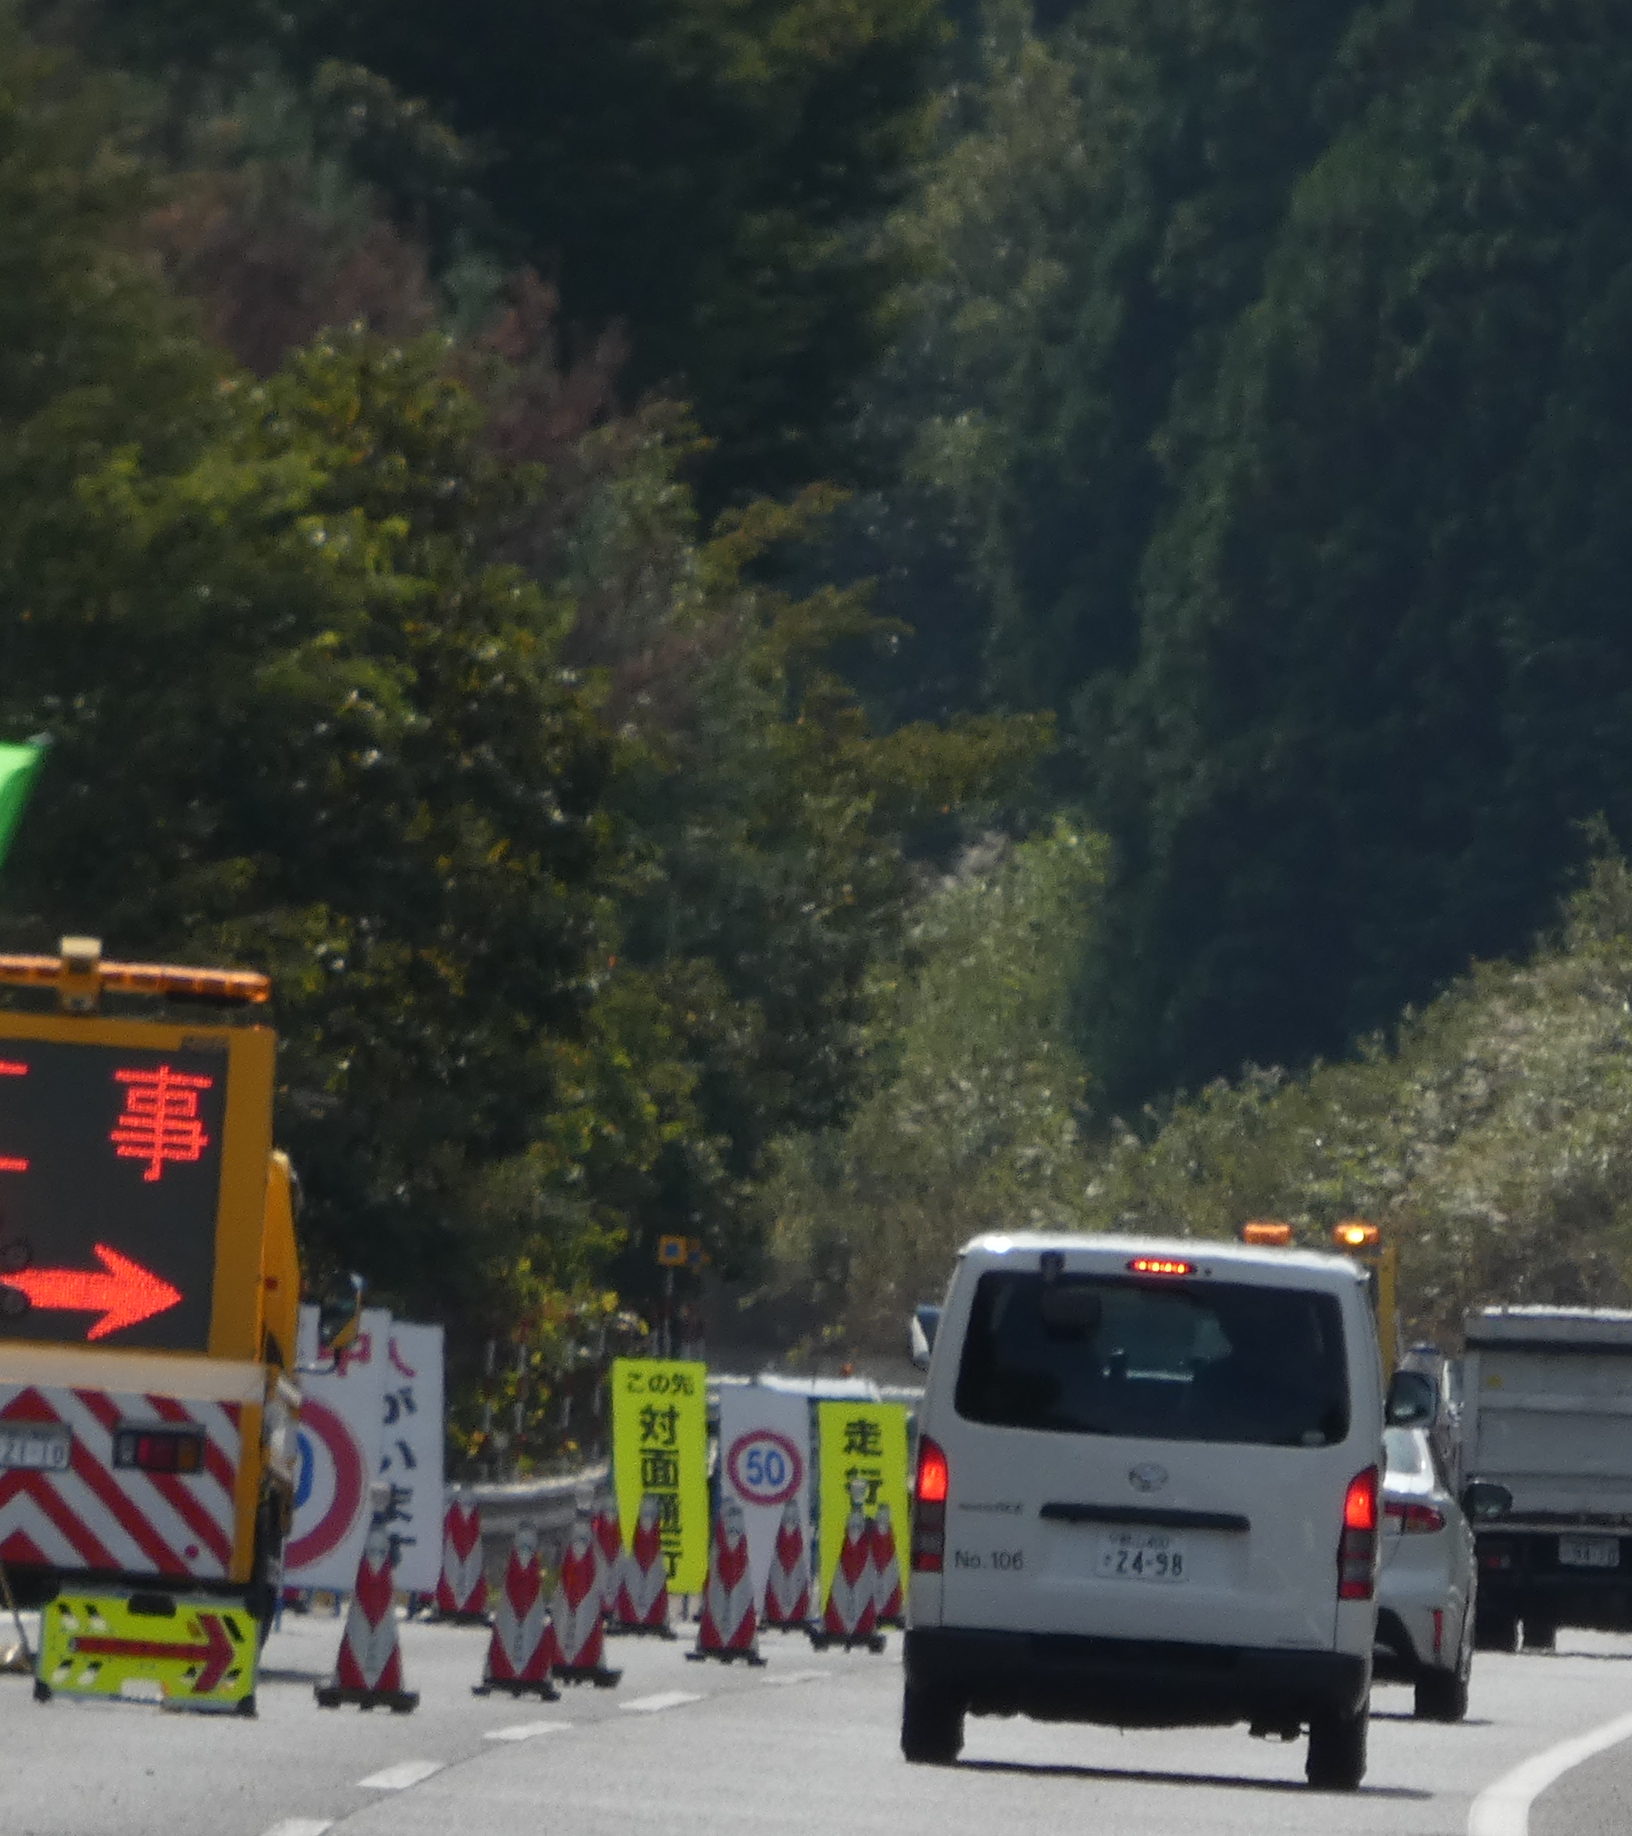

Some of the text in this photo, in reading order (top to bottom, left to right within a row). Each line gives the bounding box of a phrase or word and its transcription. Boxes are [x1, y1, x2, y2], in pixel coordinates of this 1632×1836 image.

[627, 1371, 695, 1395] この先
[746, 1448, 787, 1488] 50
